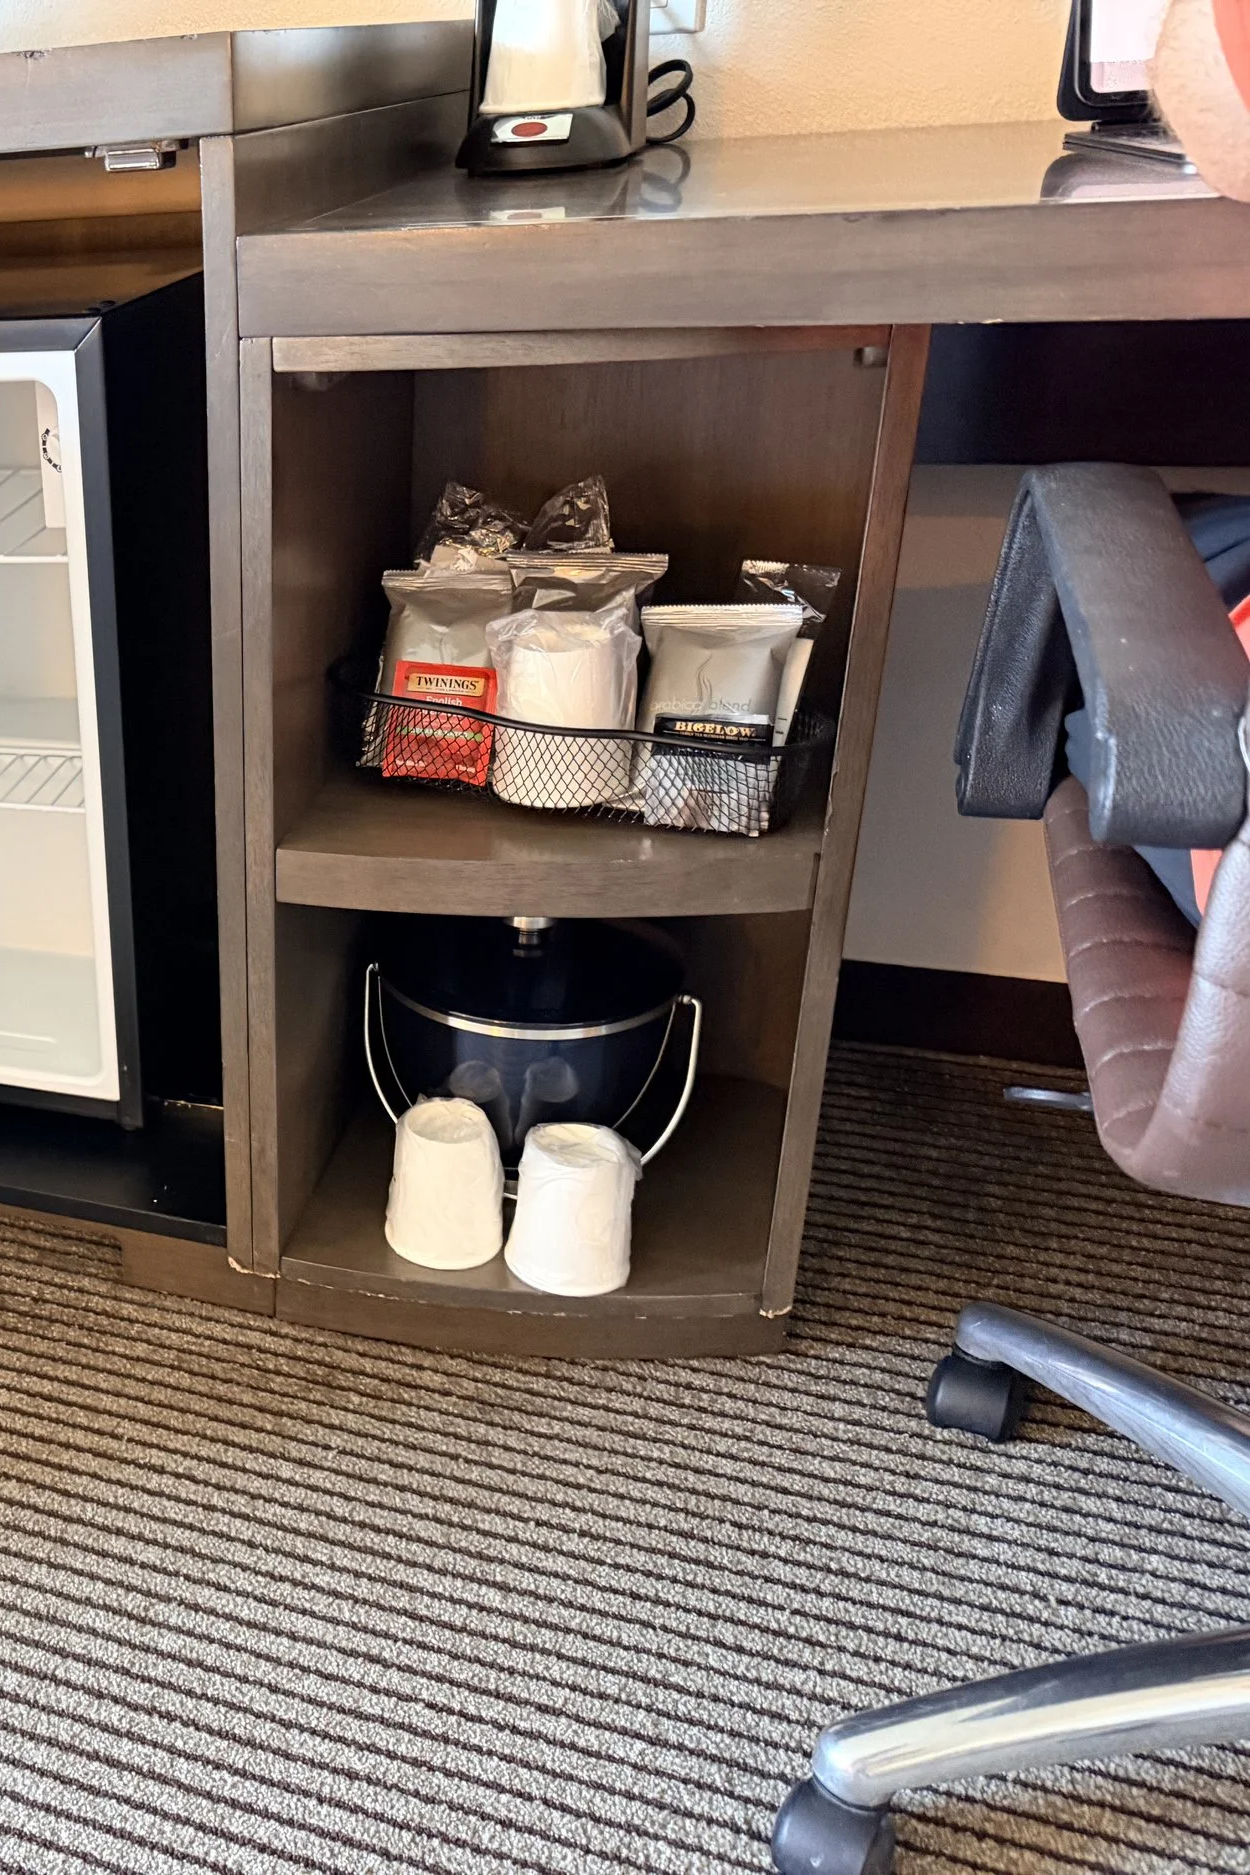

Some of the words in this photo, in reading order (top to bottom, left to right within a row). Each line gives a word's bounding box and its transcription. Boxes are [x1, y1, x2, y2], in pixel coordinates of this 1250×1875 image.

[416, 676, 477, 691] TWININGS
[708, 697, 752, 712] blend
[674, 721, 752, 737] BIGELOW
